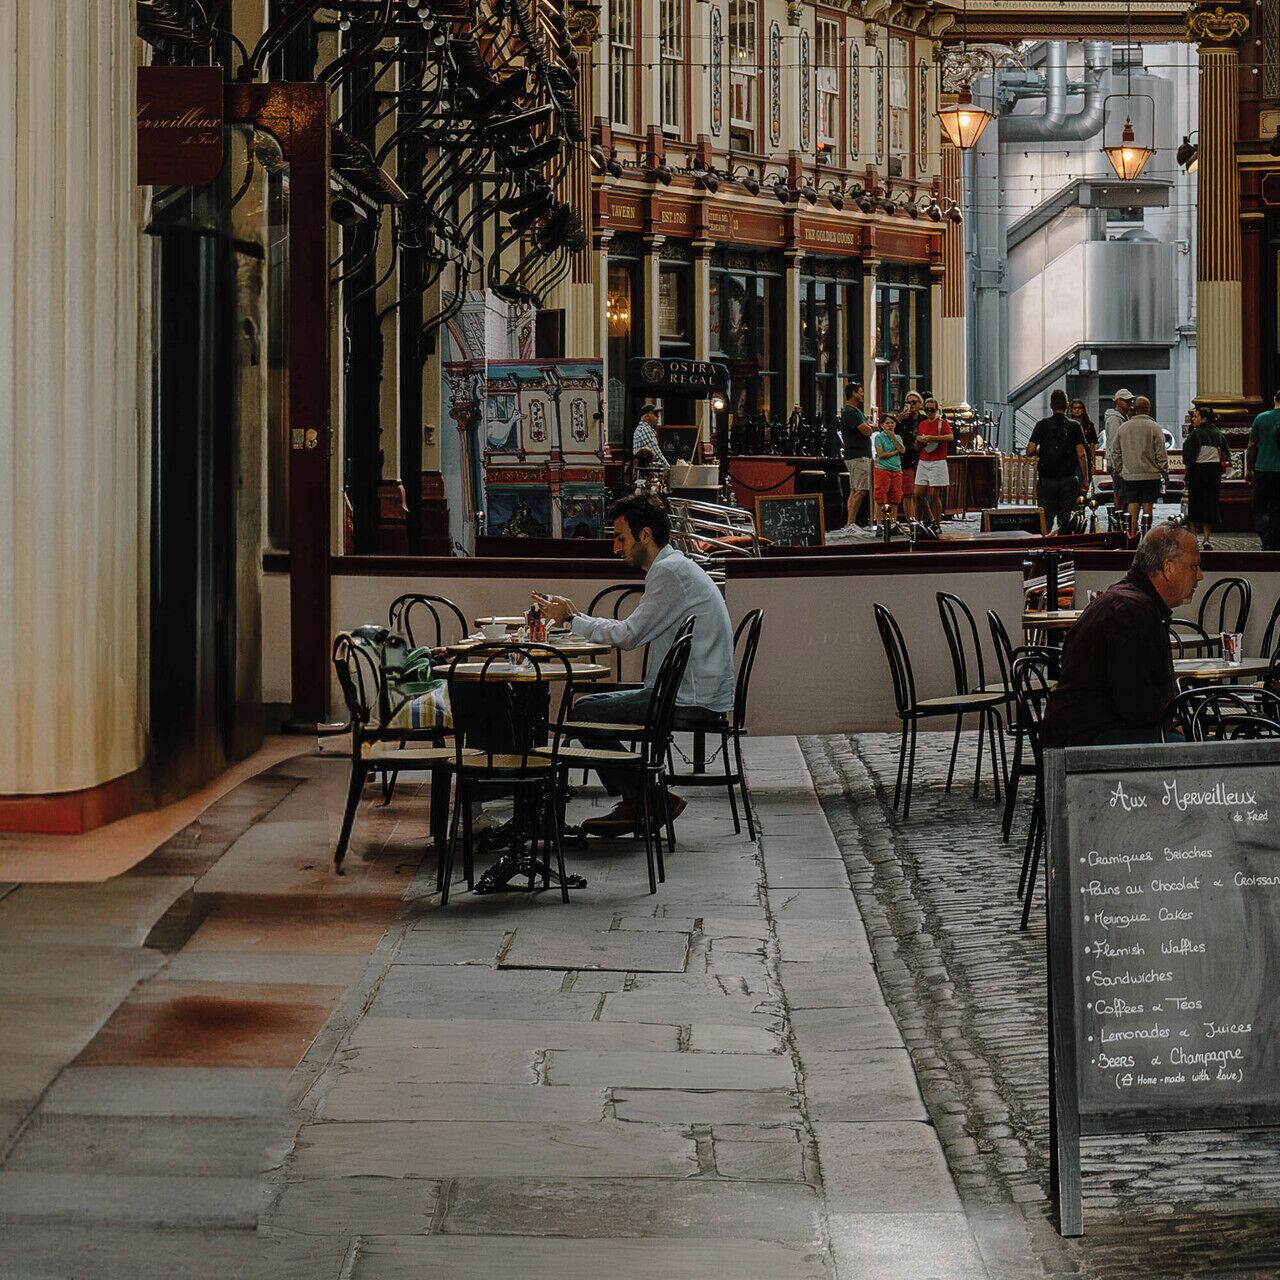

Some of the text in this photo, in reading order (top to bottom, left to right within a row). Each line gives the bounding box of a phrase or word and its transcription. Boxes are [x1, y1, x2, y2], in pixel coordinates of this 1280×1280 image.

[611, 205, 636, 219] TAVERN
[669, 361, 716, 374] OSTRA
[669, 373, 716, 385] REGAL
[1109, 780, 1148, 813] Aux
[1233, 809, 1243, 822] de
[1125, 884, 1144, 895] au
[1151, 876, 1201, 892] Chocolat
[1094, 907, 1194, 931] Meringue Cakes
[1092, 940, 1207, 959] Flemish Waffles
[1091, 969, 1174, 987] Sandwiches
[1094, 998, 1145, 1016] Coffees
[1100, 1026, 1171, 1044] Lemonades
[1203, 1020, 1253, 1039] Juices
[1170, 1047, 1245, 1069] Champagne
[1191, 1070, 1210, 1082] with
